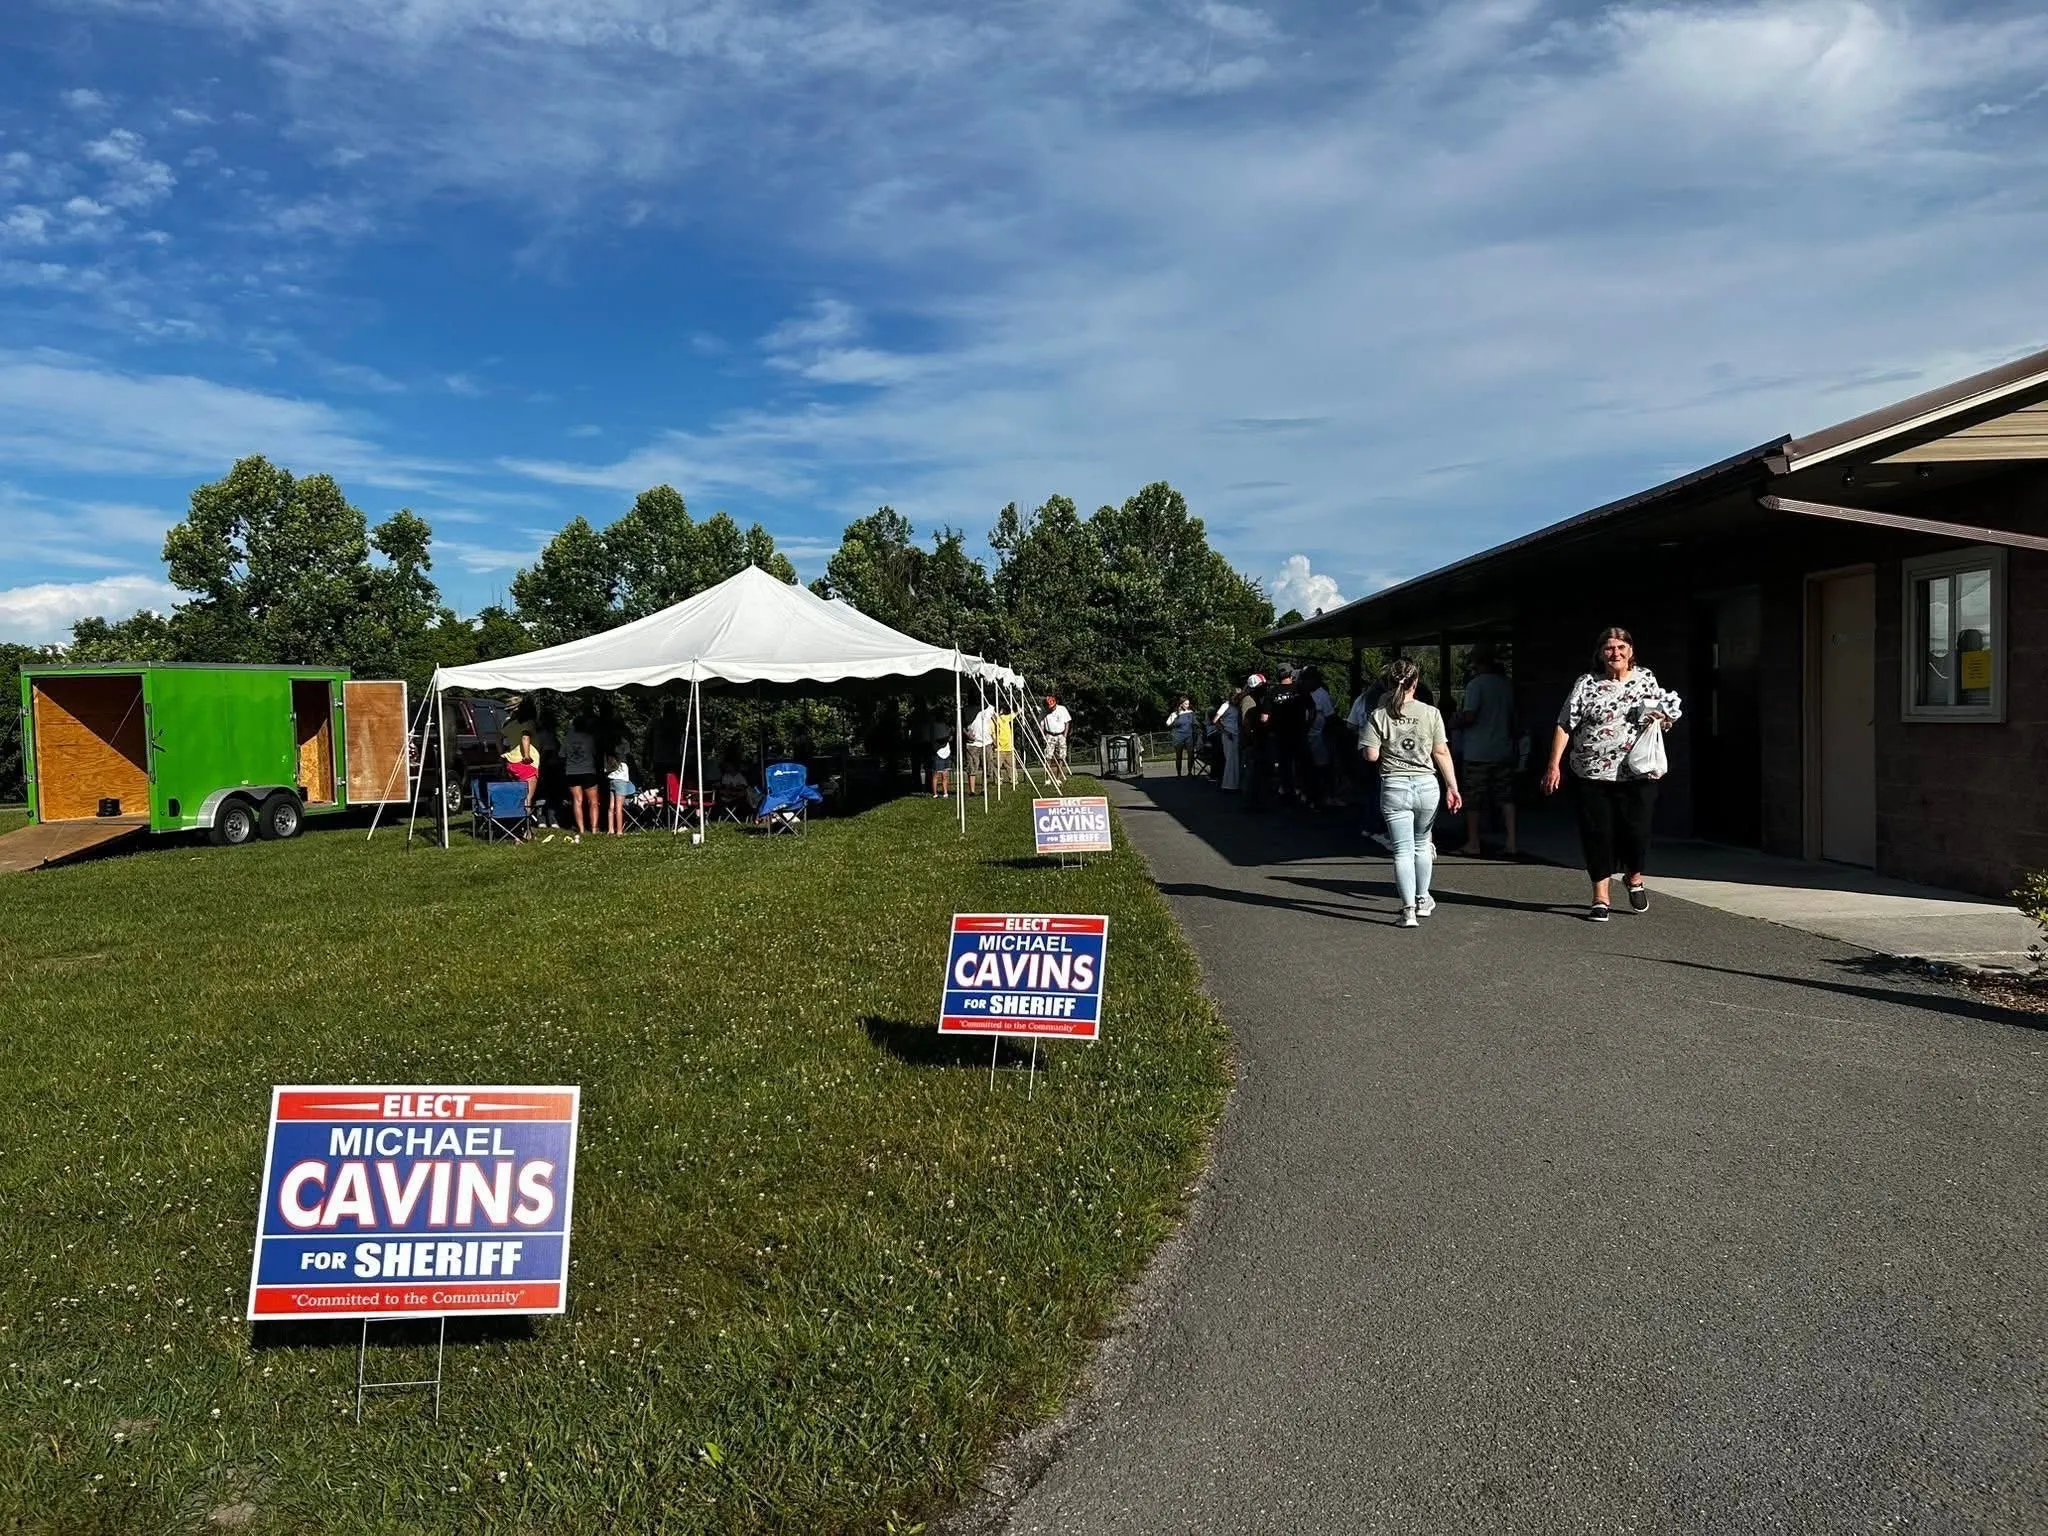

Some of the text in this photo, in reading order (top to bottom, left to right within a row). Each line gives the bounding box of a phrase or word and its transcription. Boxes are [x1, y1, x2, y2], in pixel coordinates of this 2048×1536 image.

[1392, 717, 1419, 727] VOTE
[1049, 807, 1094, 816] MICHAEL
[1039, 815, 1105, 832] CAVINS
[1059, 833, 1100, 843] SHERIFF
[1005, 918, 1050, 931] ELECT
[978, 935, 1073, 952] MICHAEL
[954, 952, 1095, 991] CAVINS
[964, 995, 1077, 1017] FOR SHERIFF
[1014, 1022, 1027, 1030] the
[383, 1095, 471, 1118] ELECT
[329, 1127, 514, 1156] MICHAEL
[279, 1159, 556, 1230] CAVINS
[301, 1241, 523, 1278] FOR SHERIFF
[291, 1289, 525, 1307] "Committed to the Community"
